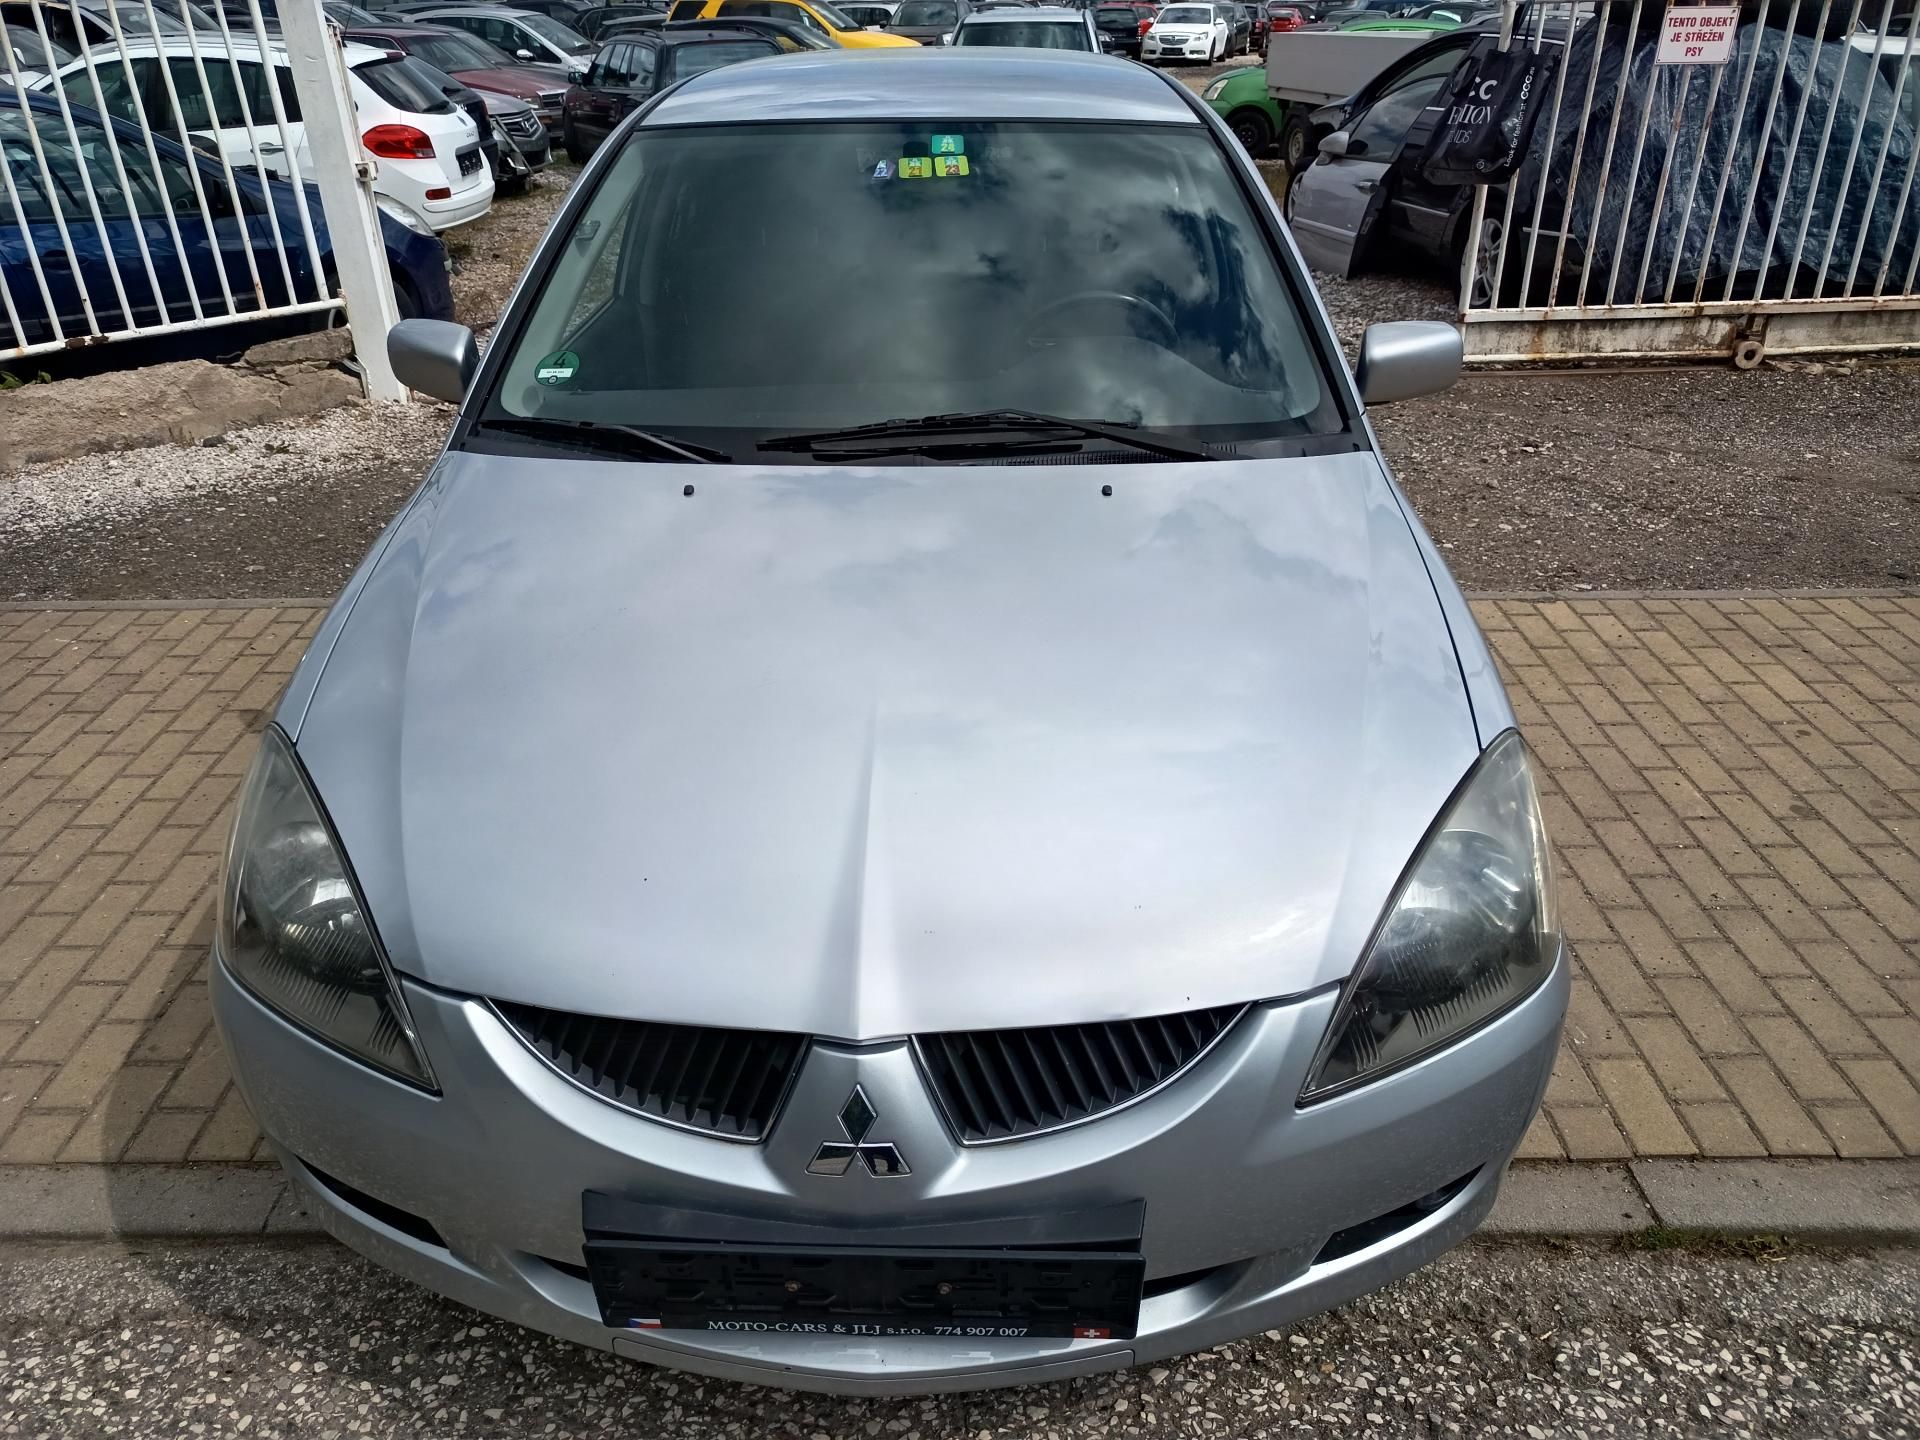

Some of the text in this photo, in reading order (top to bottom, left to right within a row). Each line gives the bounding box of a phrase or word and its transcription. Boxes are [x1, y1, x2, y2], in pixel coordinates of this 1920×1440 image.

[1669, 17, 1734, 27] TENTO OBJEKT
[1671, 29, 1724, 42] JE STŘEŽEN
[1685, 47, 1704, 56] PSY
[1504, 149, 1515, 167] Look
[1513, 112, 1524, 136] fashion
[553, 352, 567, 368] 4
[708, 1321, 1028, 1337] MOTO-CARS & JLJ s.r.o. 774 907 007
